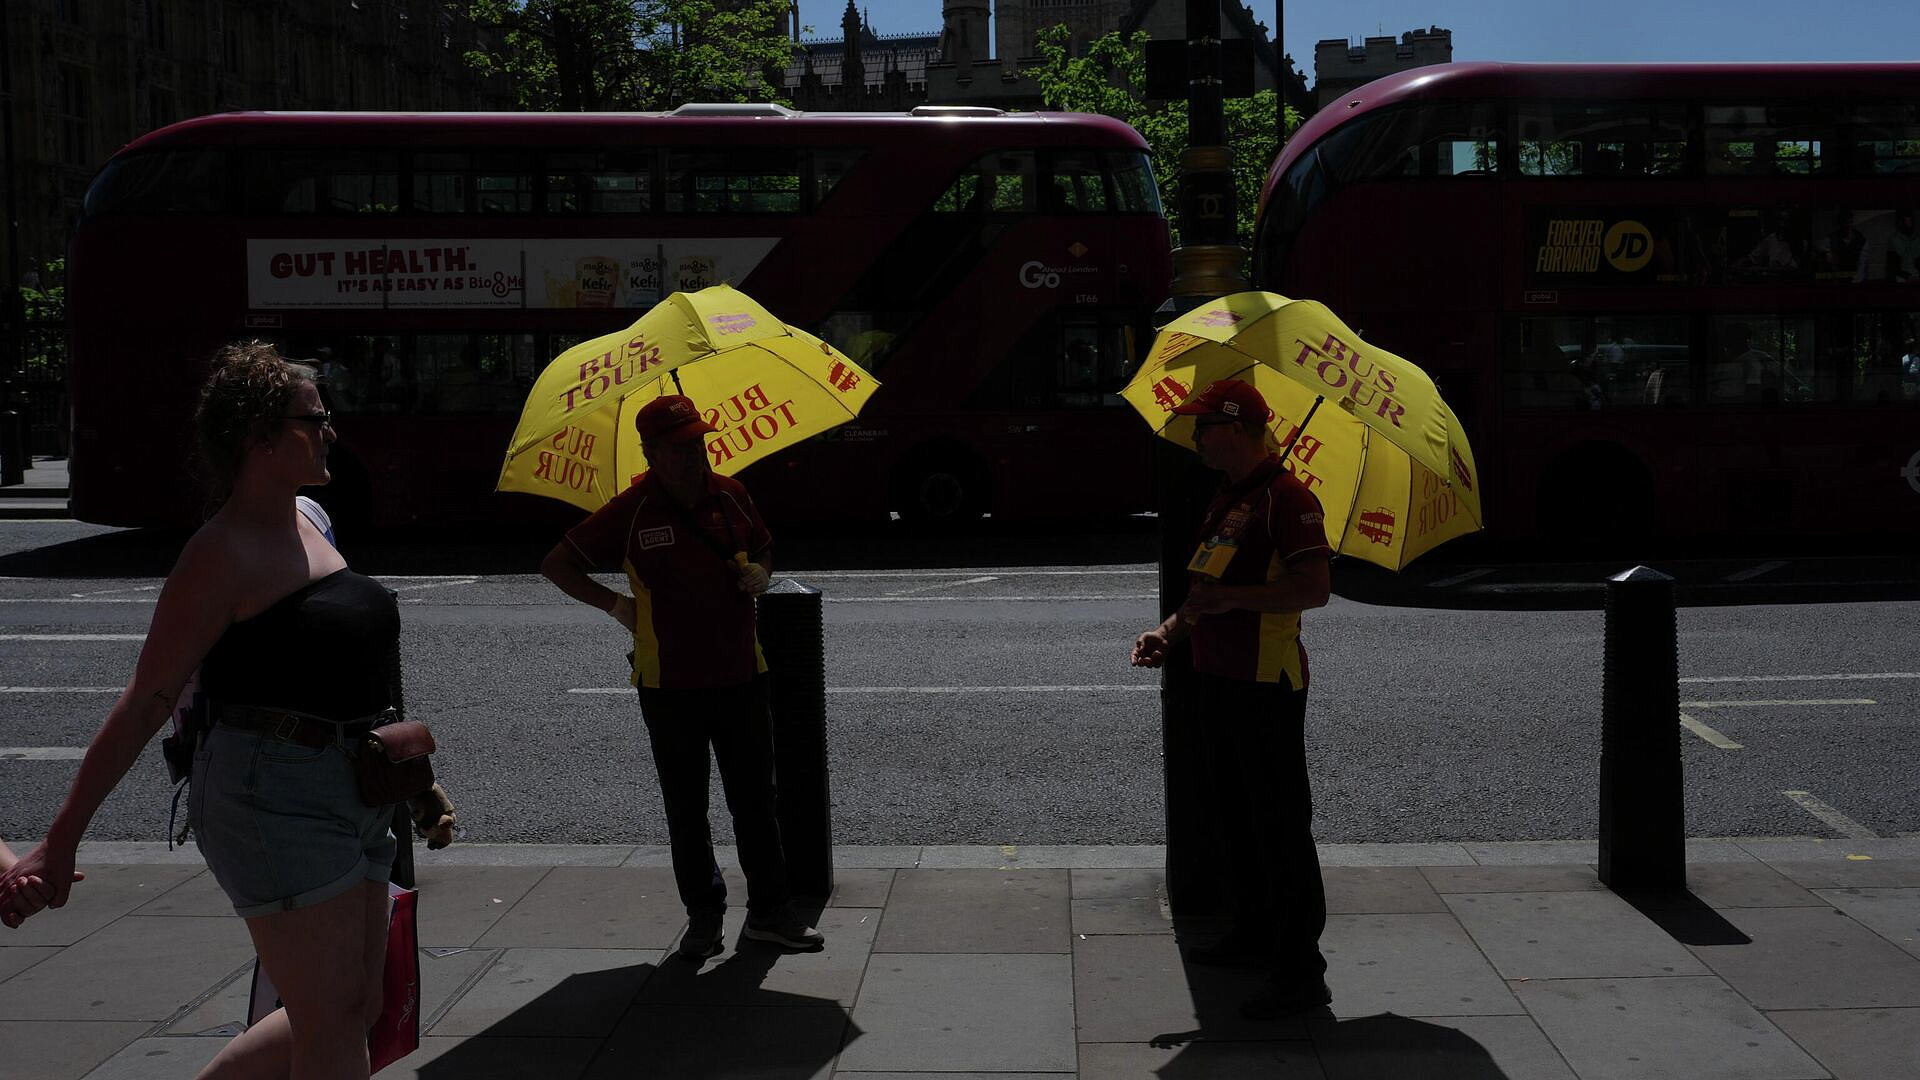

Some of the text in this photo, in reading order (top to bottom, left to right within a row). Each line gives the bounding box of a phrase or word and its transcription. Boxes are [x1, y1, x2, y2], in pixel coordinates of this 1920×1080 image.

[1546, 220, 1604, 246] FOREVER
[1611, 232, 1648, 258] JD
[270, 252, 335, 278] GUT
[1067, 264, 1098, 273] London
[1535, 246, 1600, 273] FORWARD
[336, 279, 369, 293] IT'S
[372, 279, 392, 292] AS
[397, 278, 439, 291] EASY
[443, 277, 464, 290] AS
[582, 275, 613, 291] Kefir
[1019, 260, 1060, 288] Go
[1075, 294, 1098, 304] LT66
[578, 333, 649, 383] BUS
[1320, 334, 1398, 394] BUS
[559, 345, 663, 414] TOUR
[1294, 338, 1405, 429] TOUR
